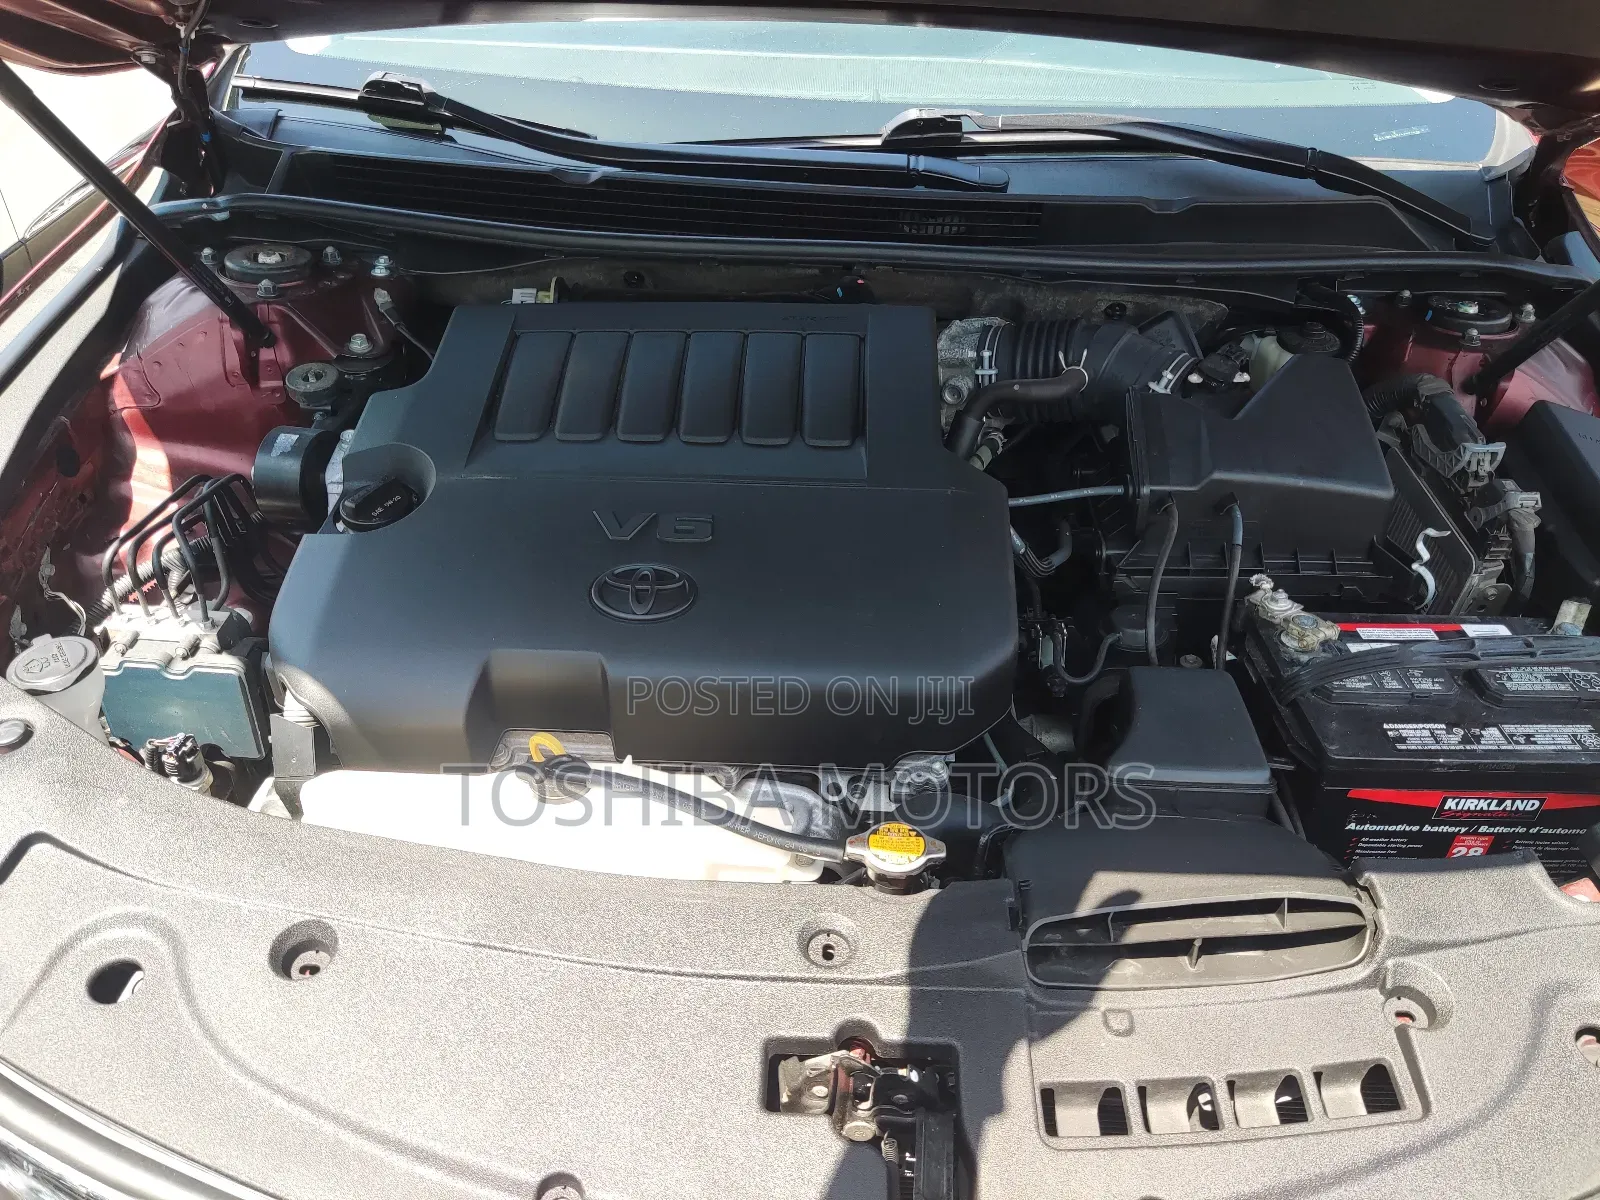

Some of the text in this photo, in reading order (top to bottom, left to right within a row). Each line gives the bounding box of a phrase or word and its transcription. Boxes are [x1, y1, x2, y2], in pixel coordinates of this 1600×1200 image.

[592, 510, 715, 543] V6
[1443, 798, 1540, 811] KIRKLAND
[1345, 823, 1420, 832] Automotive
[1422, 825, 1469, 834] battery
[1478, 825, 1527, 833] Batterie
